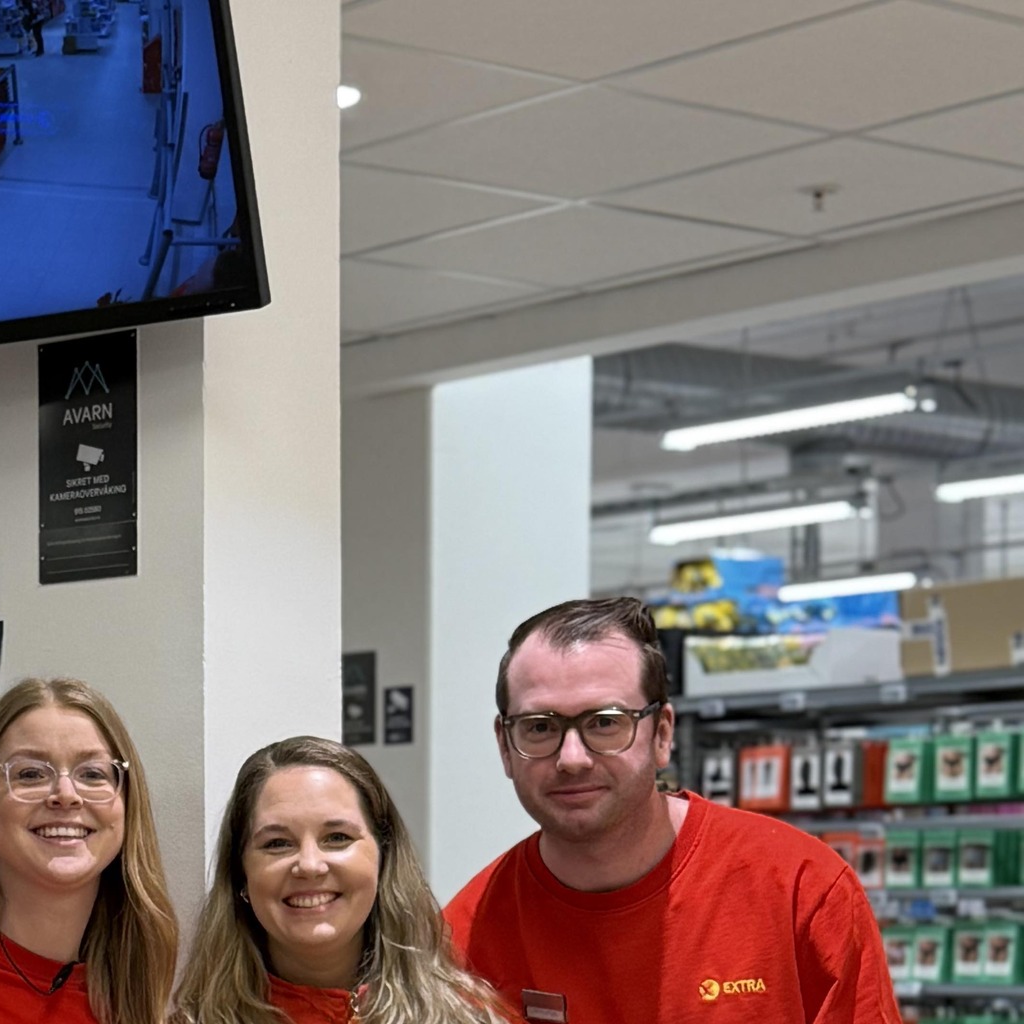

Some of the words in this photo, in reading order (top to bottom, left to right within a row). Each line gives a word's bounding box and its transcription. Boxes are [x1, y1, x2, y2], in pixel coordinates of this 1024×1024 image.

[62, 402, 112, 426] AVARN
[66, 476, 91, 488] SIKRET
[93, 474, 110, 484] MED
[49, 484, 127, 502] KAMERAOVERVÅKING
[723, 978, 766, 994] EXTRA
